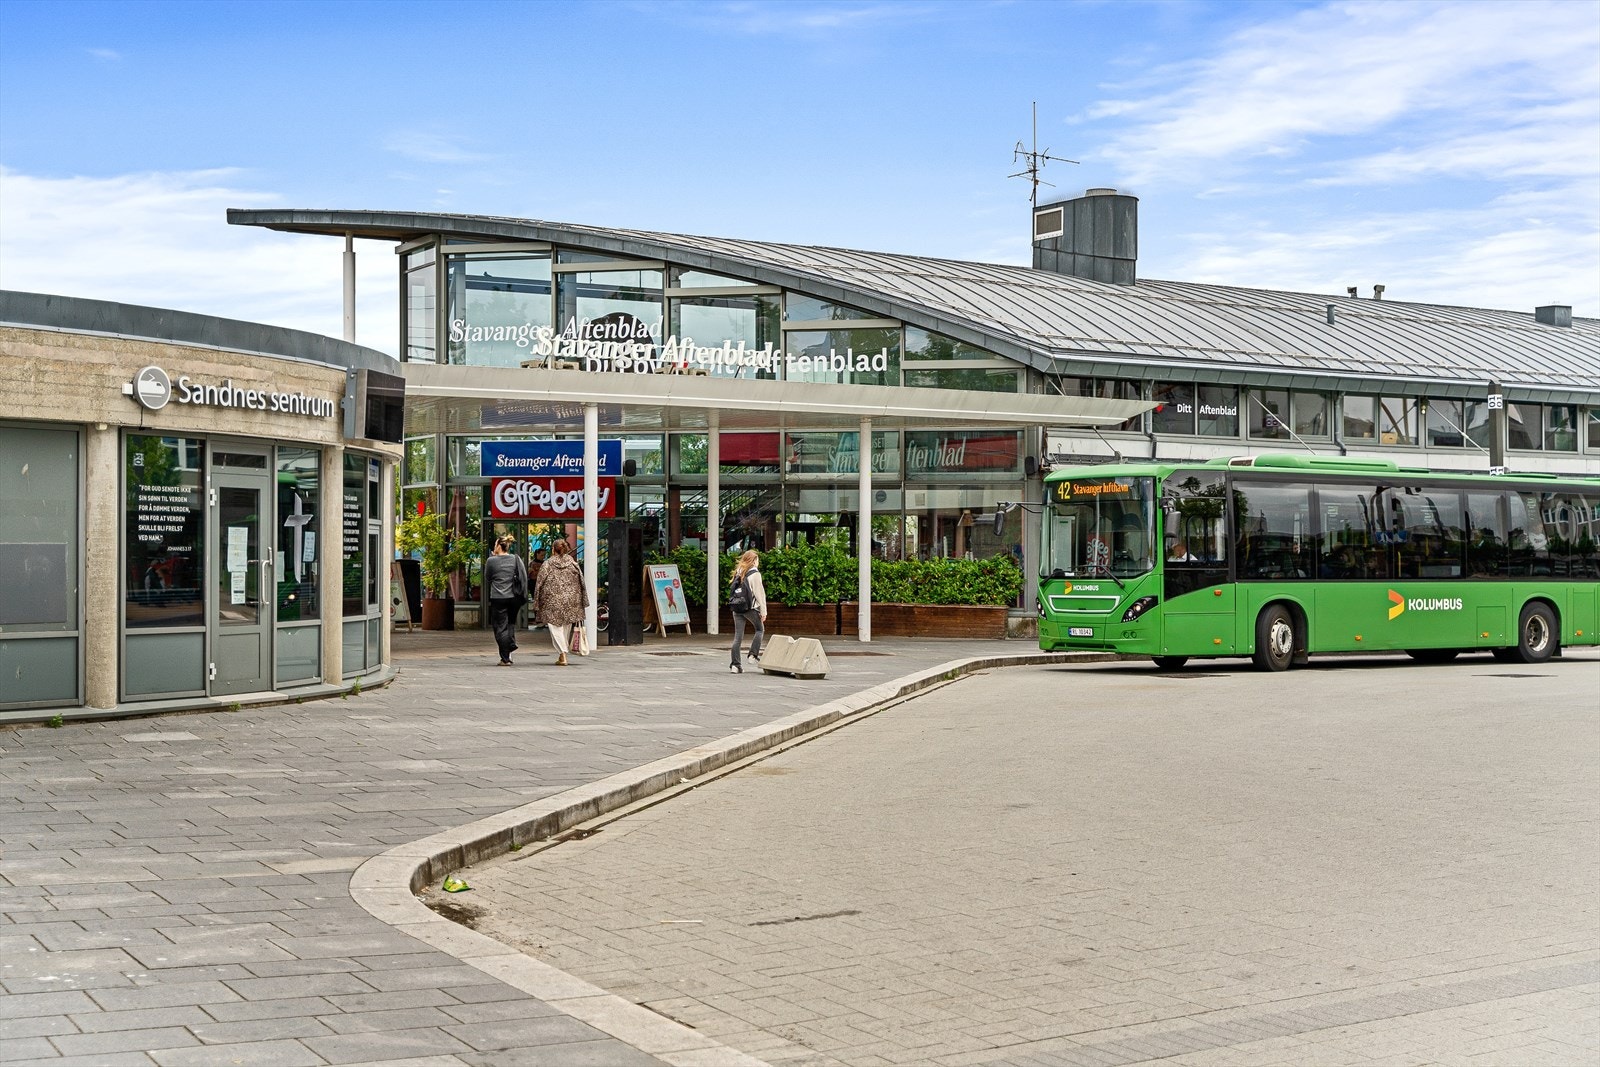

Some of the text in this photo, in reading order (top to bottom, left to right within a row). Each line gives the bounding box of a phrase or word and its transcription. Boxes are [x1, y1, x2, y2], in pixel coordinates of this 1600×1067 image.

[449, 315, 664, 347] Stavange Aftenblad
[530, 327, 773, 369] Stavanger Aftenblad
[178, 375, 335, 418] Sandnes sentrum
[1177, 403, 1237, 416] Ditt Aftenblad
[495, 454, 552, 471] Stavanger
[494, 479, 611, 515] Coffeebery
[1058, 481, 1129, 500] 42 Stavanger lufthavn
[1073, 584, 1099, 592] KOLUMBUS
[1408, 598, 1463, 611] KOLUMBUS
